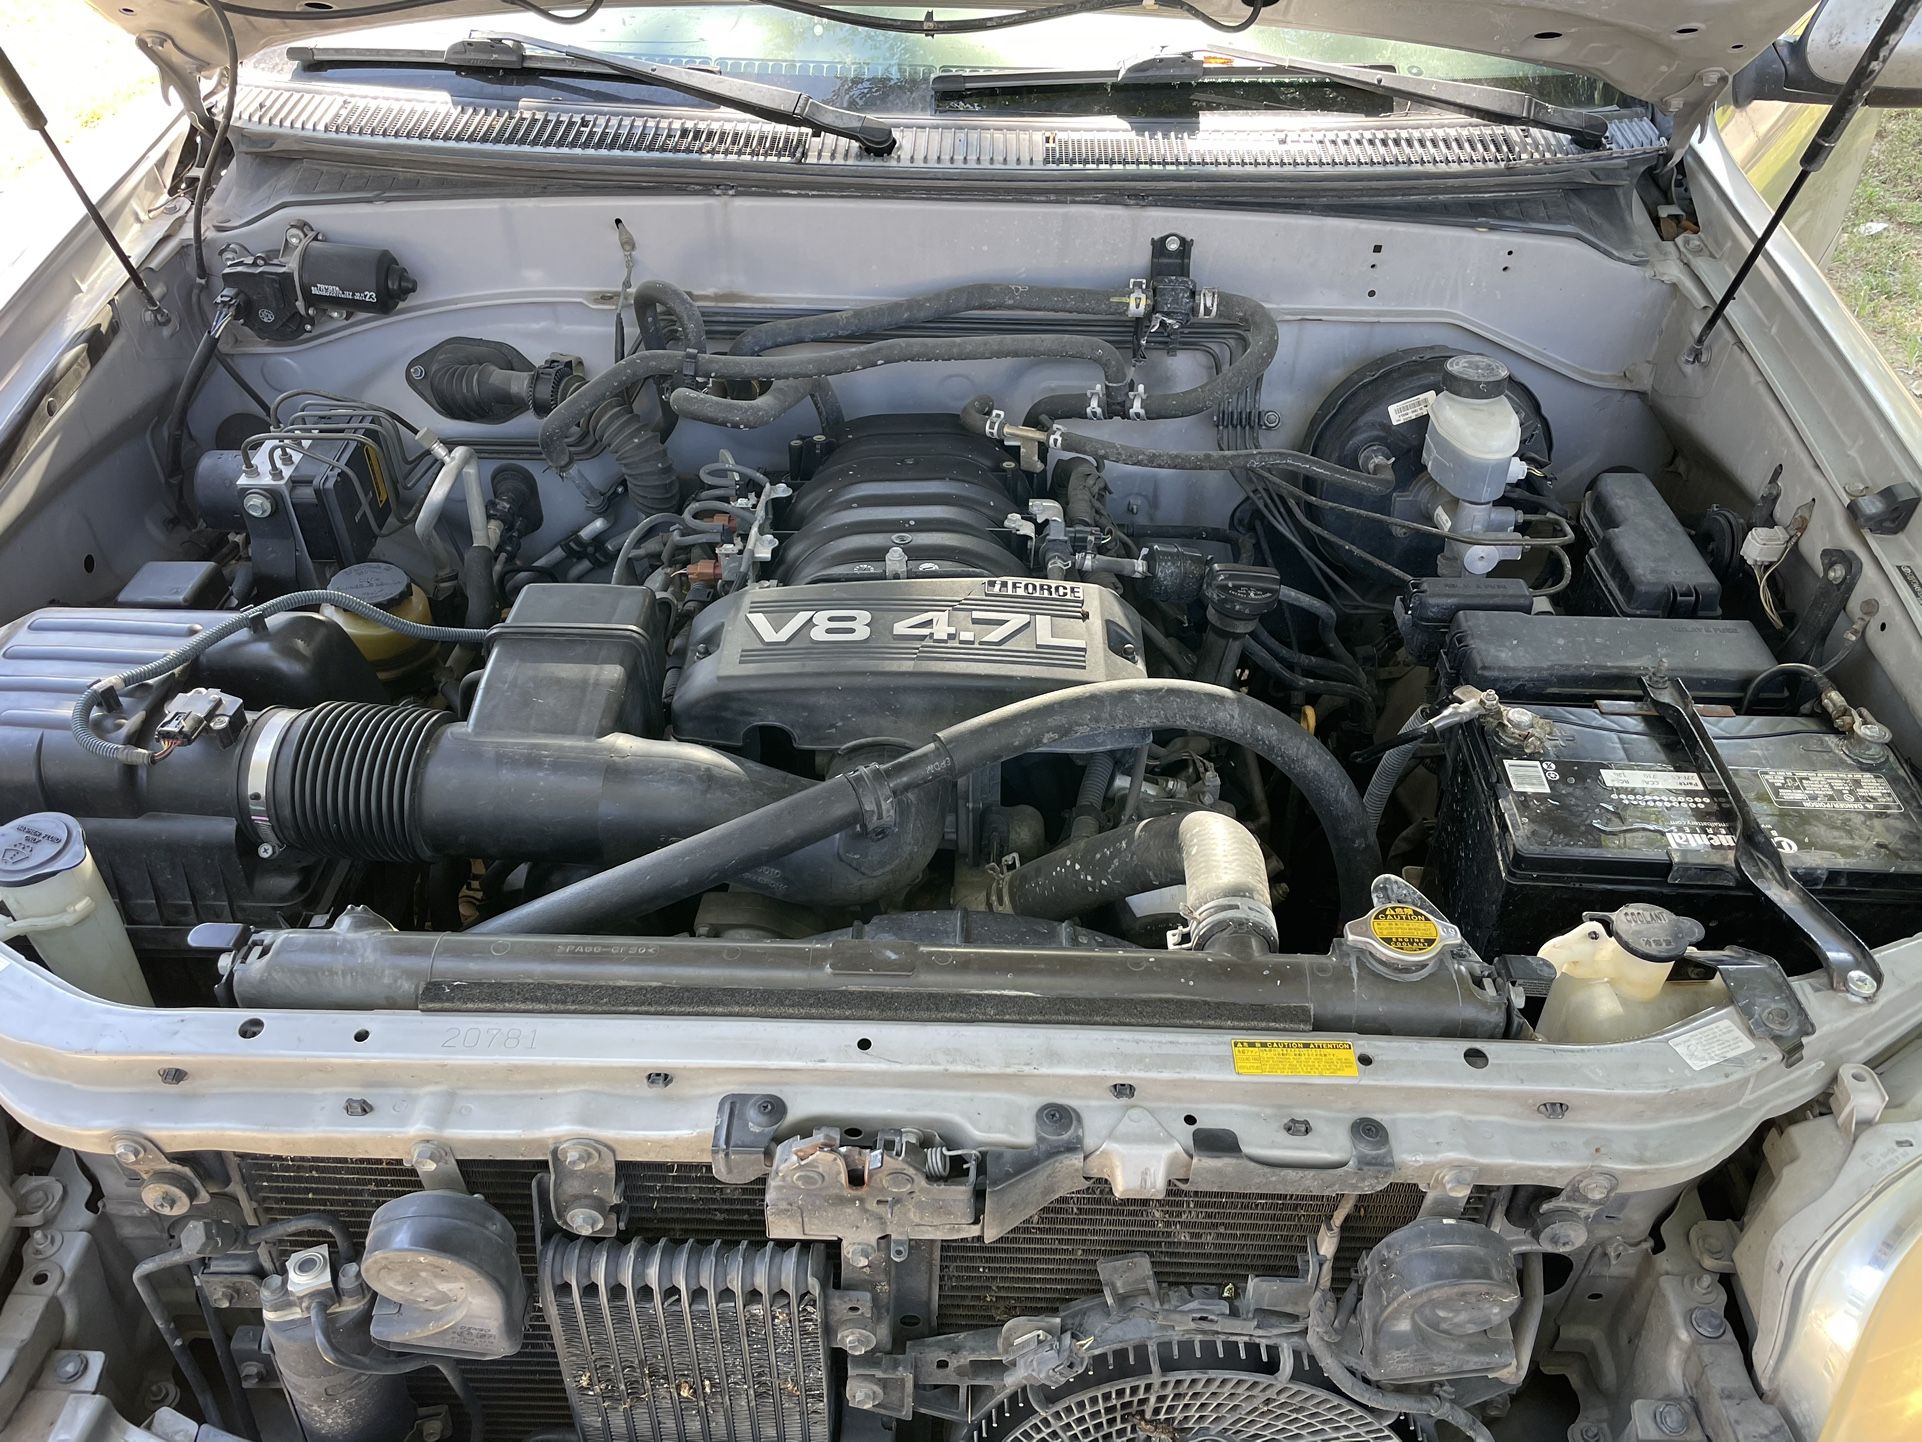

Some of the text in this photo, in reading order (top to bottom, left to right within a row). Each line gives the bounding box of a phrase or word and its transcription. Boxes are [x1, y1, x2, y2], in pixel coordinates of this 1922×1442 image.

[364, 291, 377, 302] 23
[746, 609, 1086, 648] V8 4.7L
[1623, 912, 1667, 924] COOLANT
[441, 1027, 537, 1049] 20781
